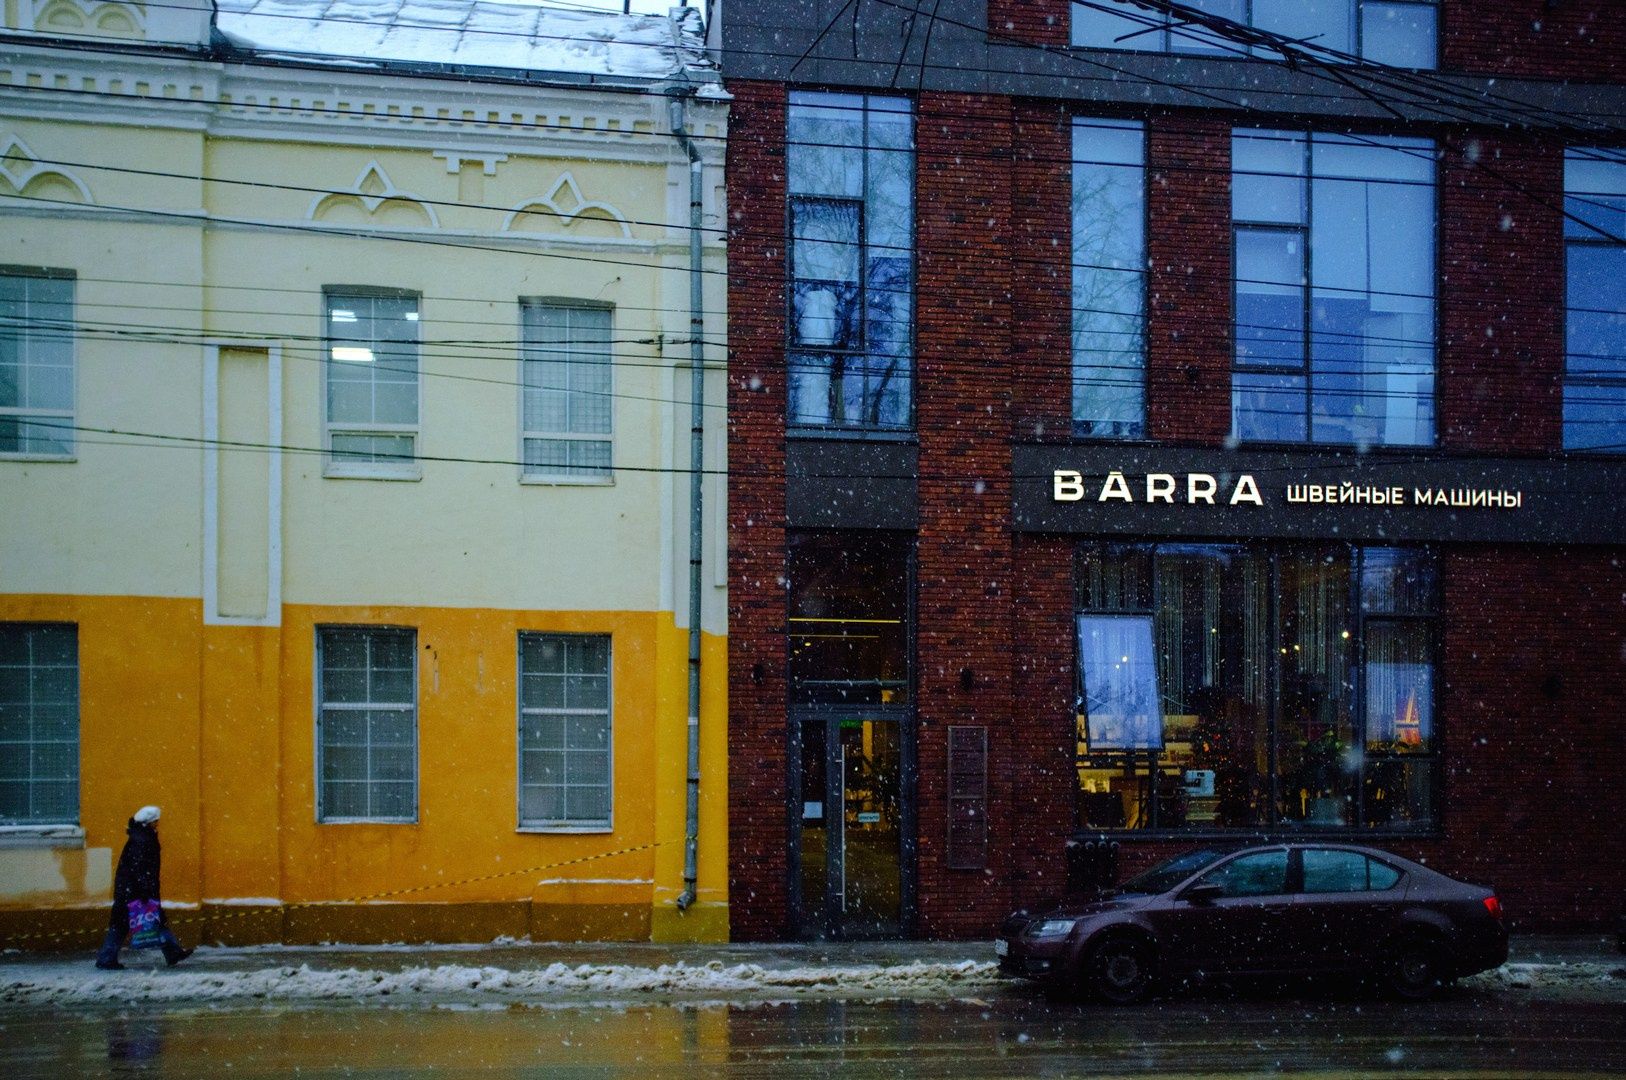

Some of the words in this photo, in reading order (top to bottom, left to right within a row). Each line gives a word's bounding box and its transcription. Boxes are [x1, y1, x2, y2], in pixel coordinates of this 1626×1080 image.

[1053, 469, 1264, 506] BARRA
[1287, 481, 1404, 505] ШВЕЙНЫЕ
[1414, 487, 1522, 508] МАШИНЫ
